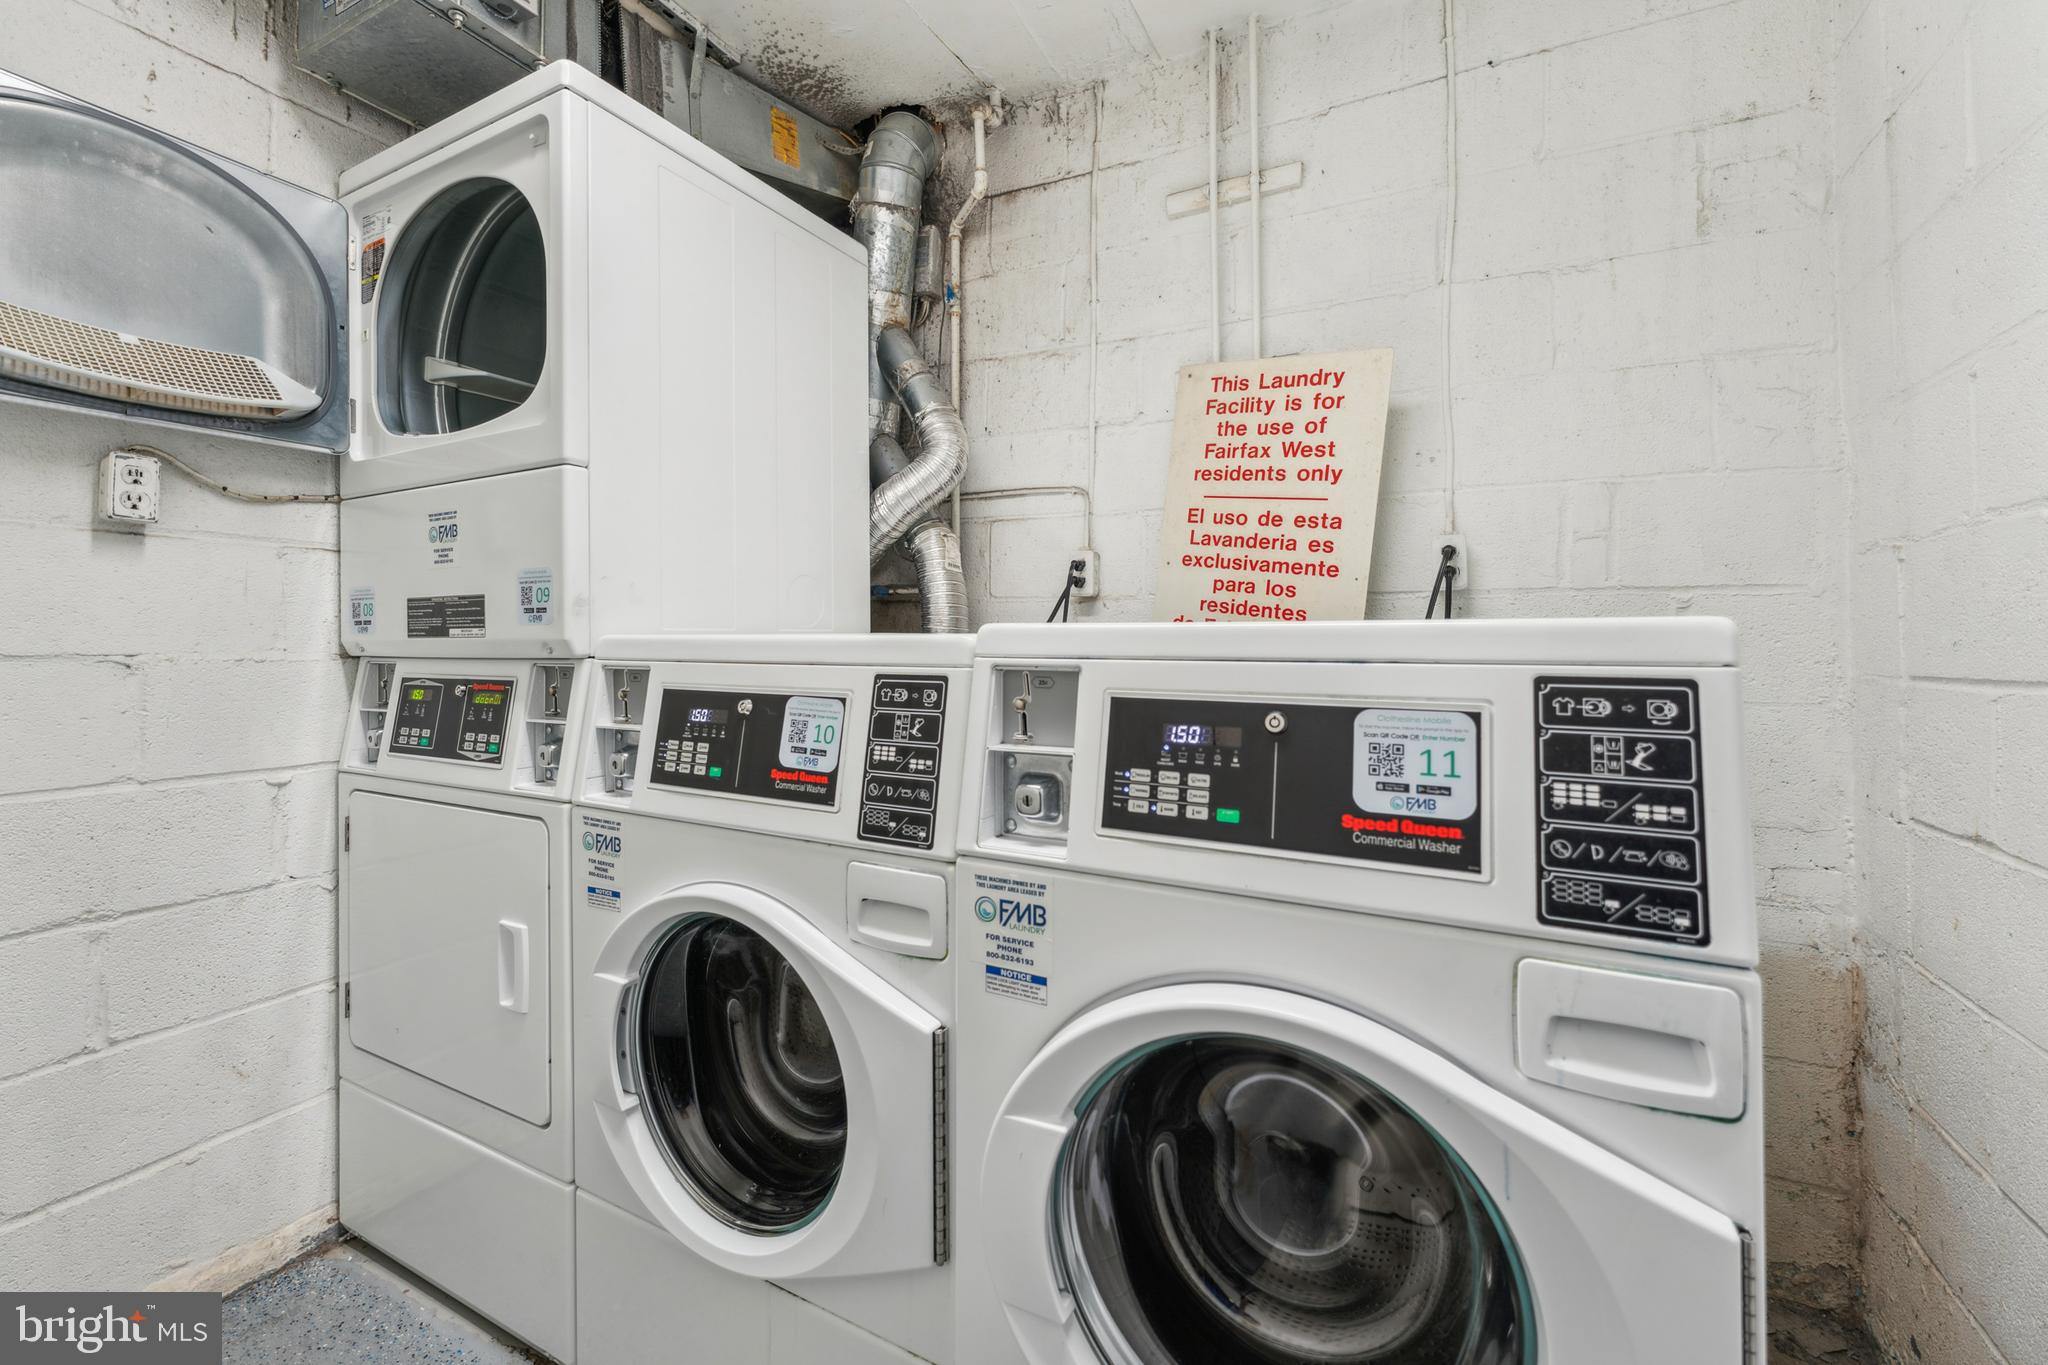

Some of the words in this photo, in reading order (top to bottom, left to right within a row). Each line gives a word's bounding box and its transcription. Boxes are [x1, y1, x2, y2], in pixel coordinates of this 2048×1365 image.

[1211, 375, 1249, 393] This
[1259, 368, 1345, 390] Laundry
[1206, 396, 1275, 415] Facility
[1285, 394, 1302, 411] is
[1313, 393, 1345, 410] for
[1217, 421, 1247, 437] the
[1257, 421, 1294, 436] use
[1304, 416, 1327, 434] of
[1204, 443, 1271, 459] Fairfax
[1281, 440, 1336, 458] West
[1194, 465, 1286, 481] residents
[1297, 464, 1343, 485] only
[1187, 508, 1205, 524] El
[1213, 512, 1248, 526] uso
[1258, 510, 1283, 527] de
[1294, 513, 1343, 530] esta
[438, 524, 458, 543] FMB
[1190, 529, 1297, 551] Lavanderia
[1308, 538, 1335, 554] es
[1182, 553, 1340, 578] exclusivamente
[536, 587, 550, 603] 09
[1212, 578, 1256, 594] para
[1265, 579, 1297, 598] los
[363, 602, 374, 617] 08
[1200, 599, 1307, 622] residentes
[813, 723, 835, 745] 10
[1420, 749, 1461, 779] 11
[770, 768, 799, 781] Speed
[799, 771, 829, 784] Queen
[775, 780, 805, 792] Commercial
[806, 784, 827, 794] Washer
[1406, 797, 1437, 812] FMB
[1341, 814, 1399, 832] Speed
[1401, 819, 1463, 839] Queen
[595, 833, 622, 854] FMB
[1352, 831, 1416, 850] Commercial
[1418, 837, 1462, 854] Washer
[999, 898, 1047, 927] FMB
[1009, 922, 1046, 936] LAUNDRY
[985, 932, 1000, 941] FOR
[1002, 936, 1035, 948] SERVICE
[997, 944, 1023, 955] PHONE
[986, 950, 1034, 966] 800-832-6193
[1000, 968, 1033, 983] NOTICE
